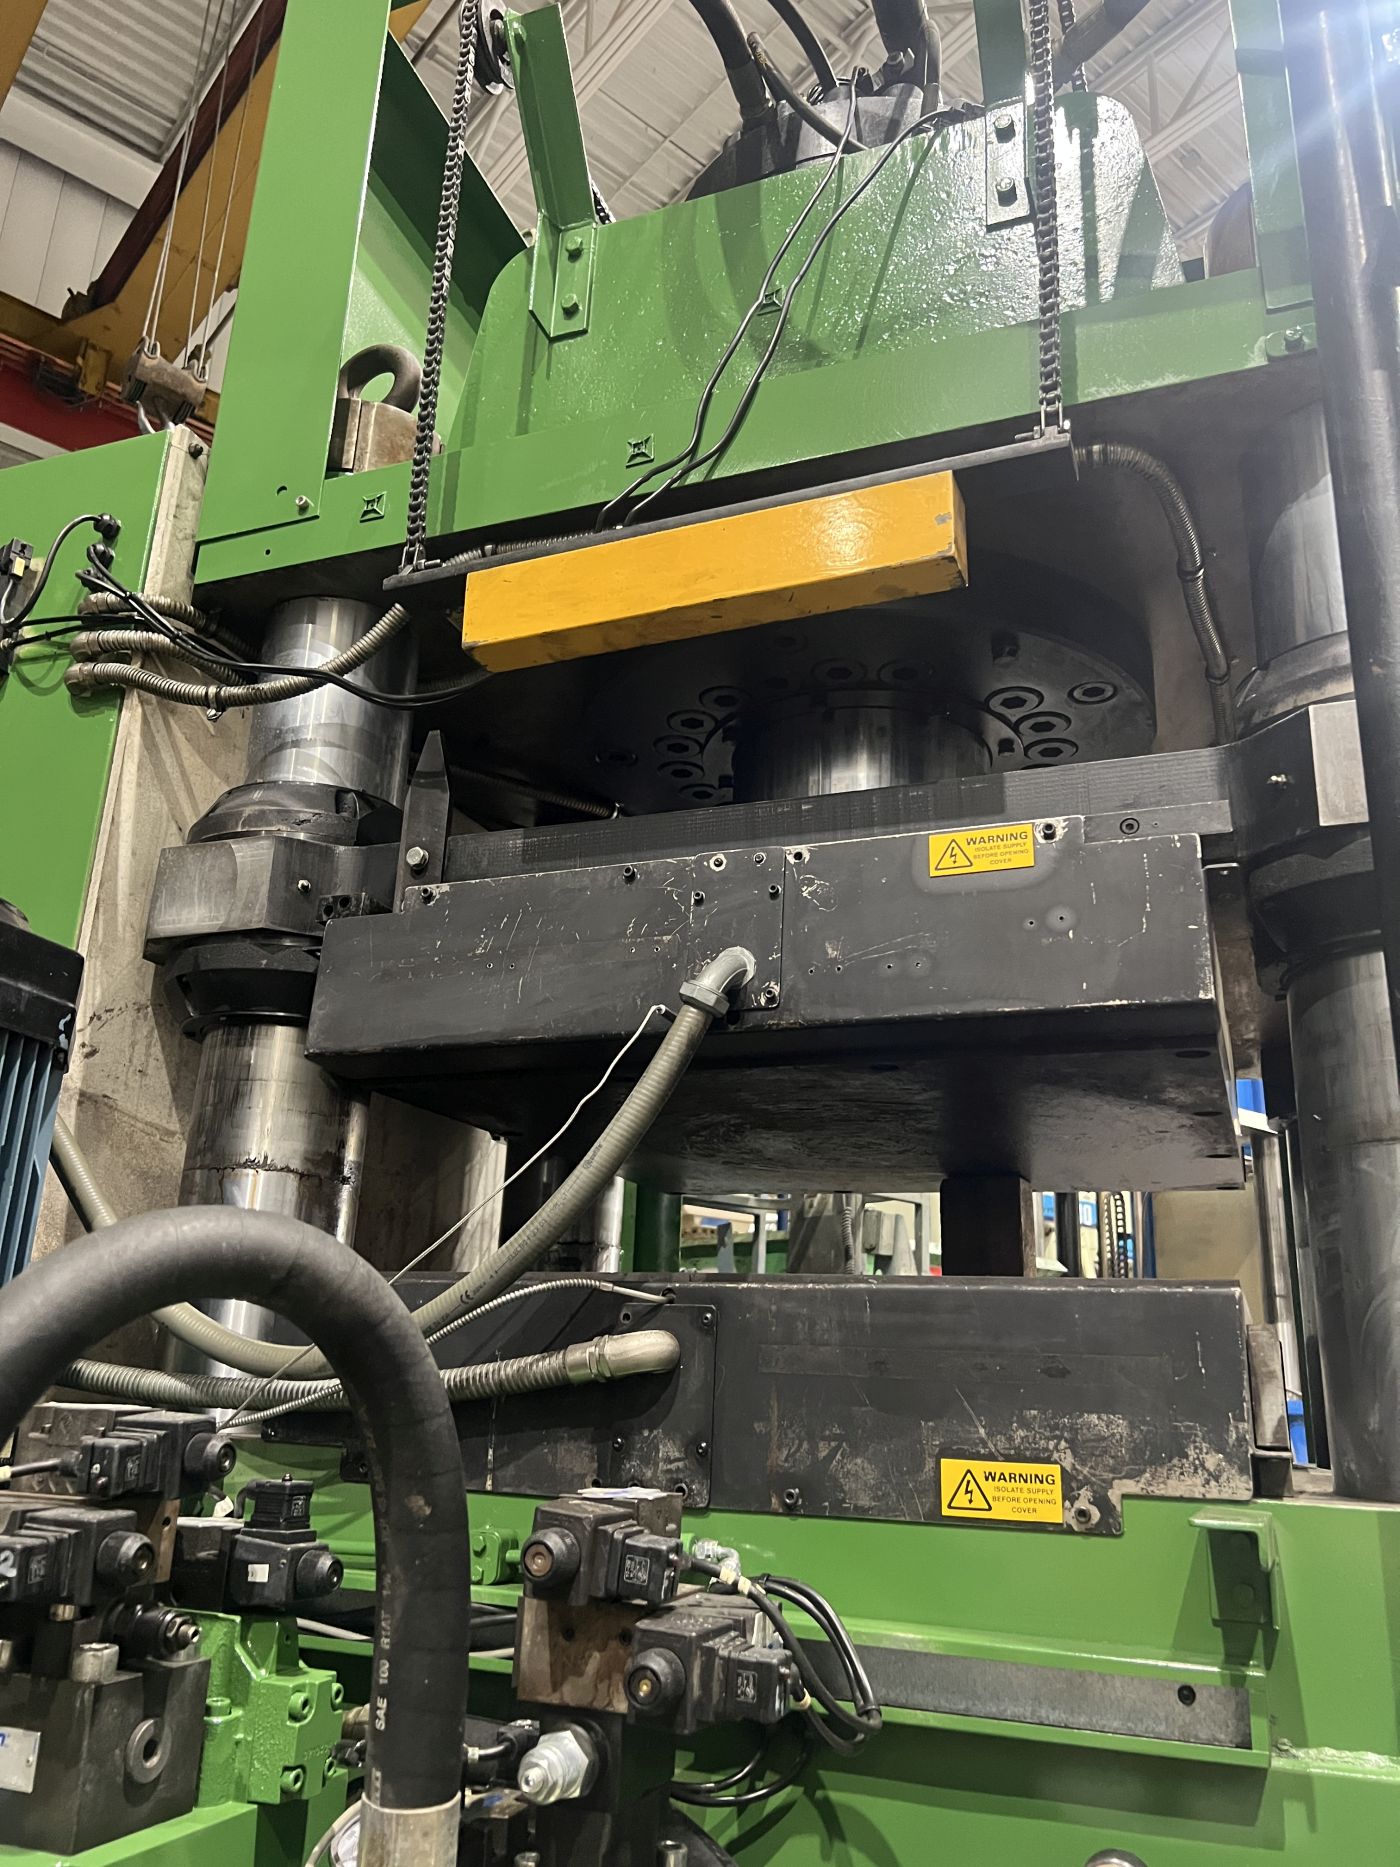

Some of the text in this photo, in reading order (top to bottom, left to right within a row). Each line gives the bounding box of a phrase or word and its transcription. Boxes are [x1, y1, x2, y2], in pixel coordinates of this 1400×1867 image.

[966, 832, 1028, 846] WARNING
[975, 842, 1027, 852] ISOLATE SUPPLY
[973, 849, 1029, 860] BEFORE OPENING
[984, 1471, 1055, 1485] WARNING
[1023, 1497, 1057, 1505] OPENING
[379, 1659, 389, 1684] 100
[375, 1696, 387, 1731] SAE
